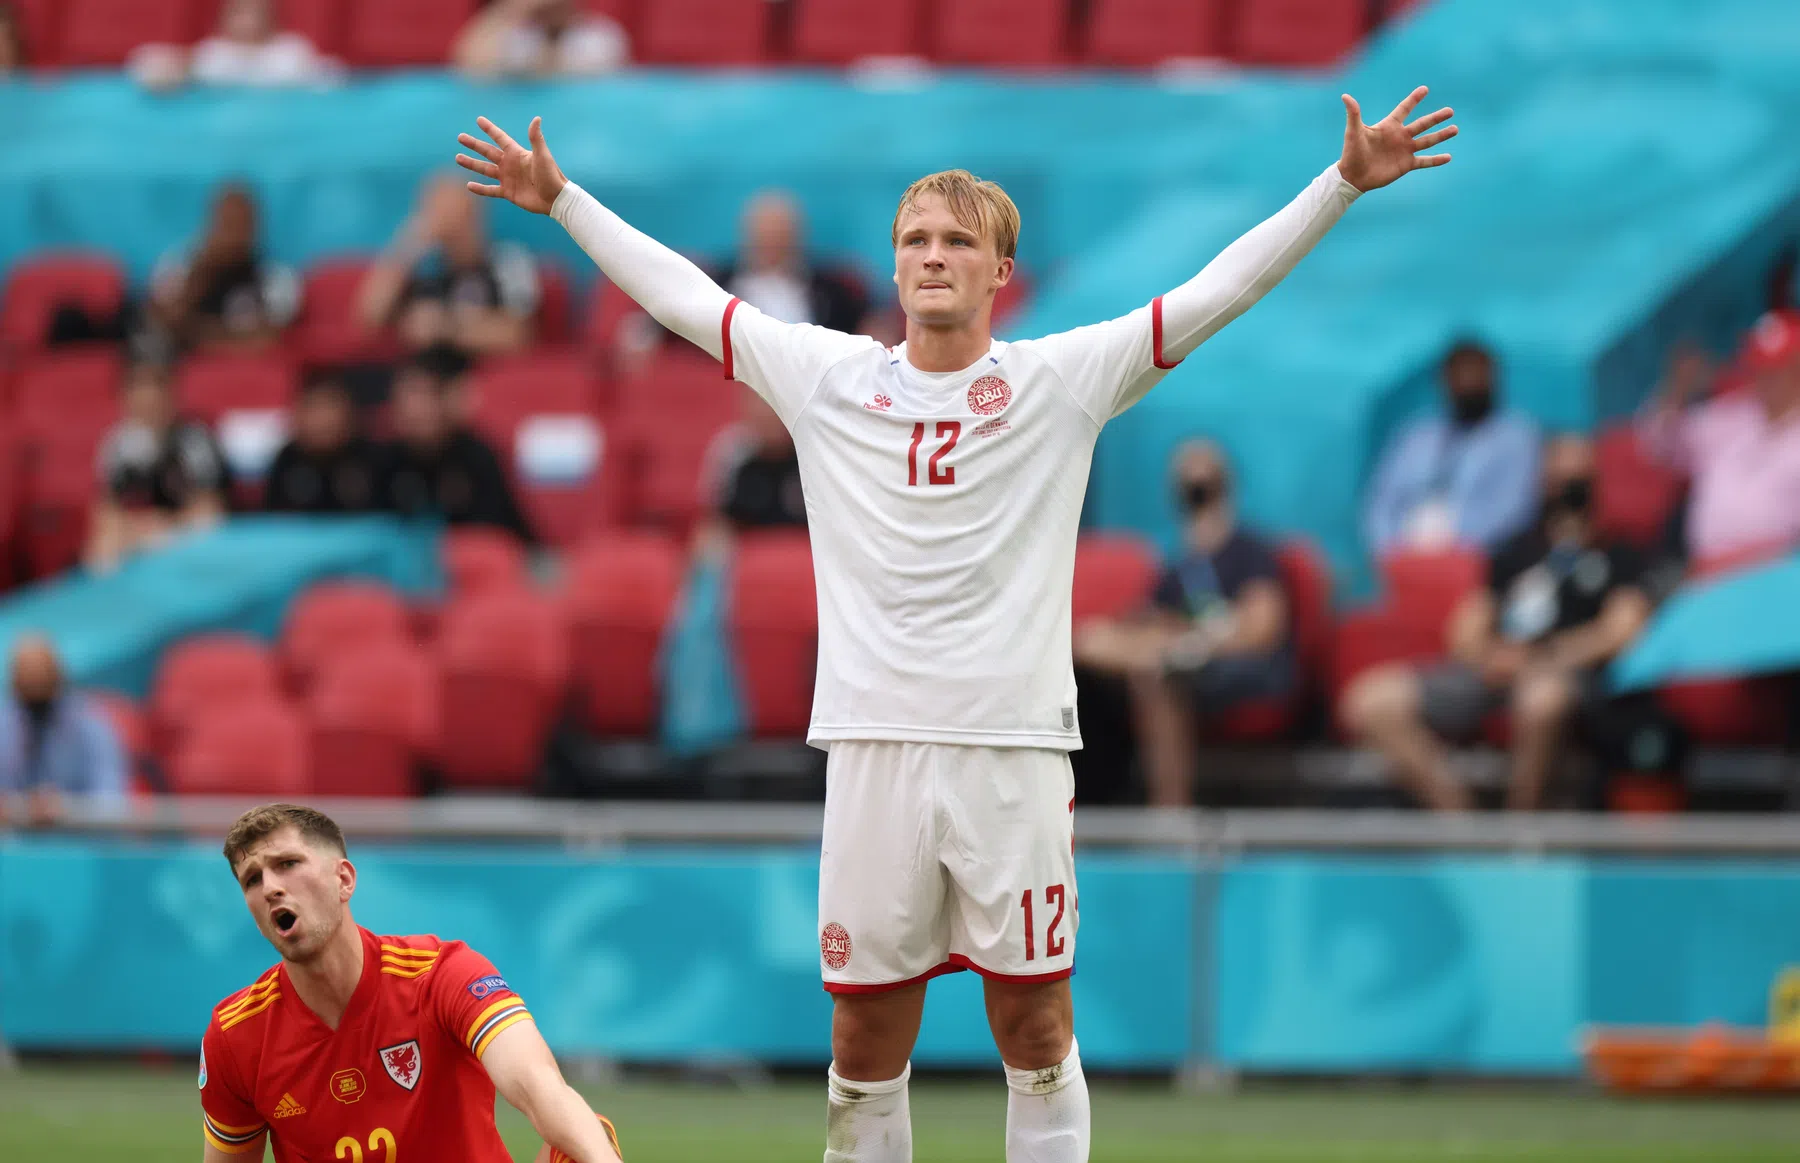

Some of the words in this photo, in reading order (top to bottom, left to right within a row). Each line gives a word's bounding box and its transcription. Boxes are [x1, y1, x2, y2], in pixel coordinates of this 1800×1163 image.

[975, 386, 1004, 407] DBU
[907, 421, 961, 486] 12
[1020, 883, 1065, 961] 12
[826, 938, 846, 953] DBU
[273, 1106, 307, 1119] adidas
